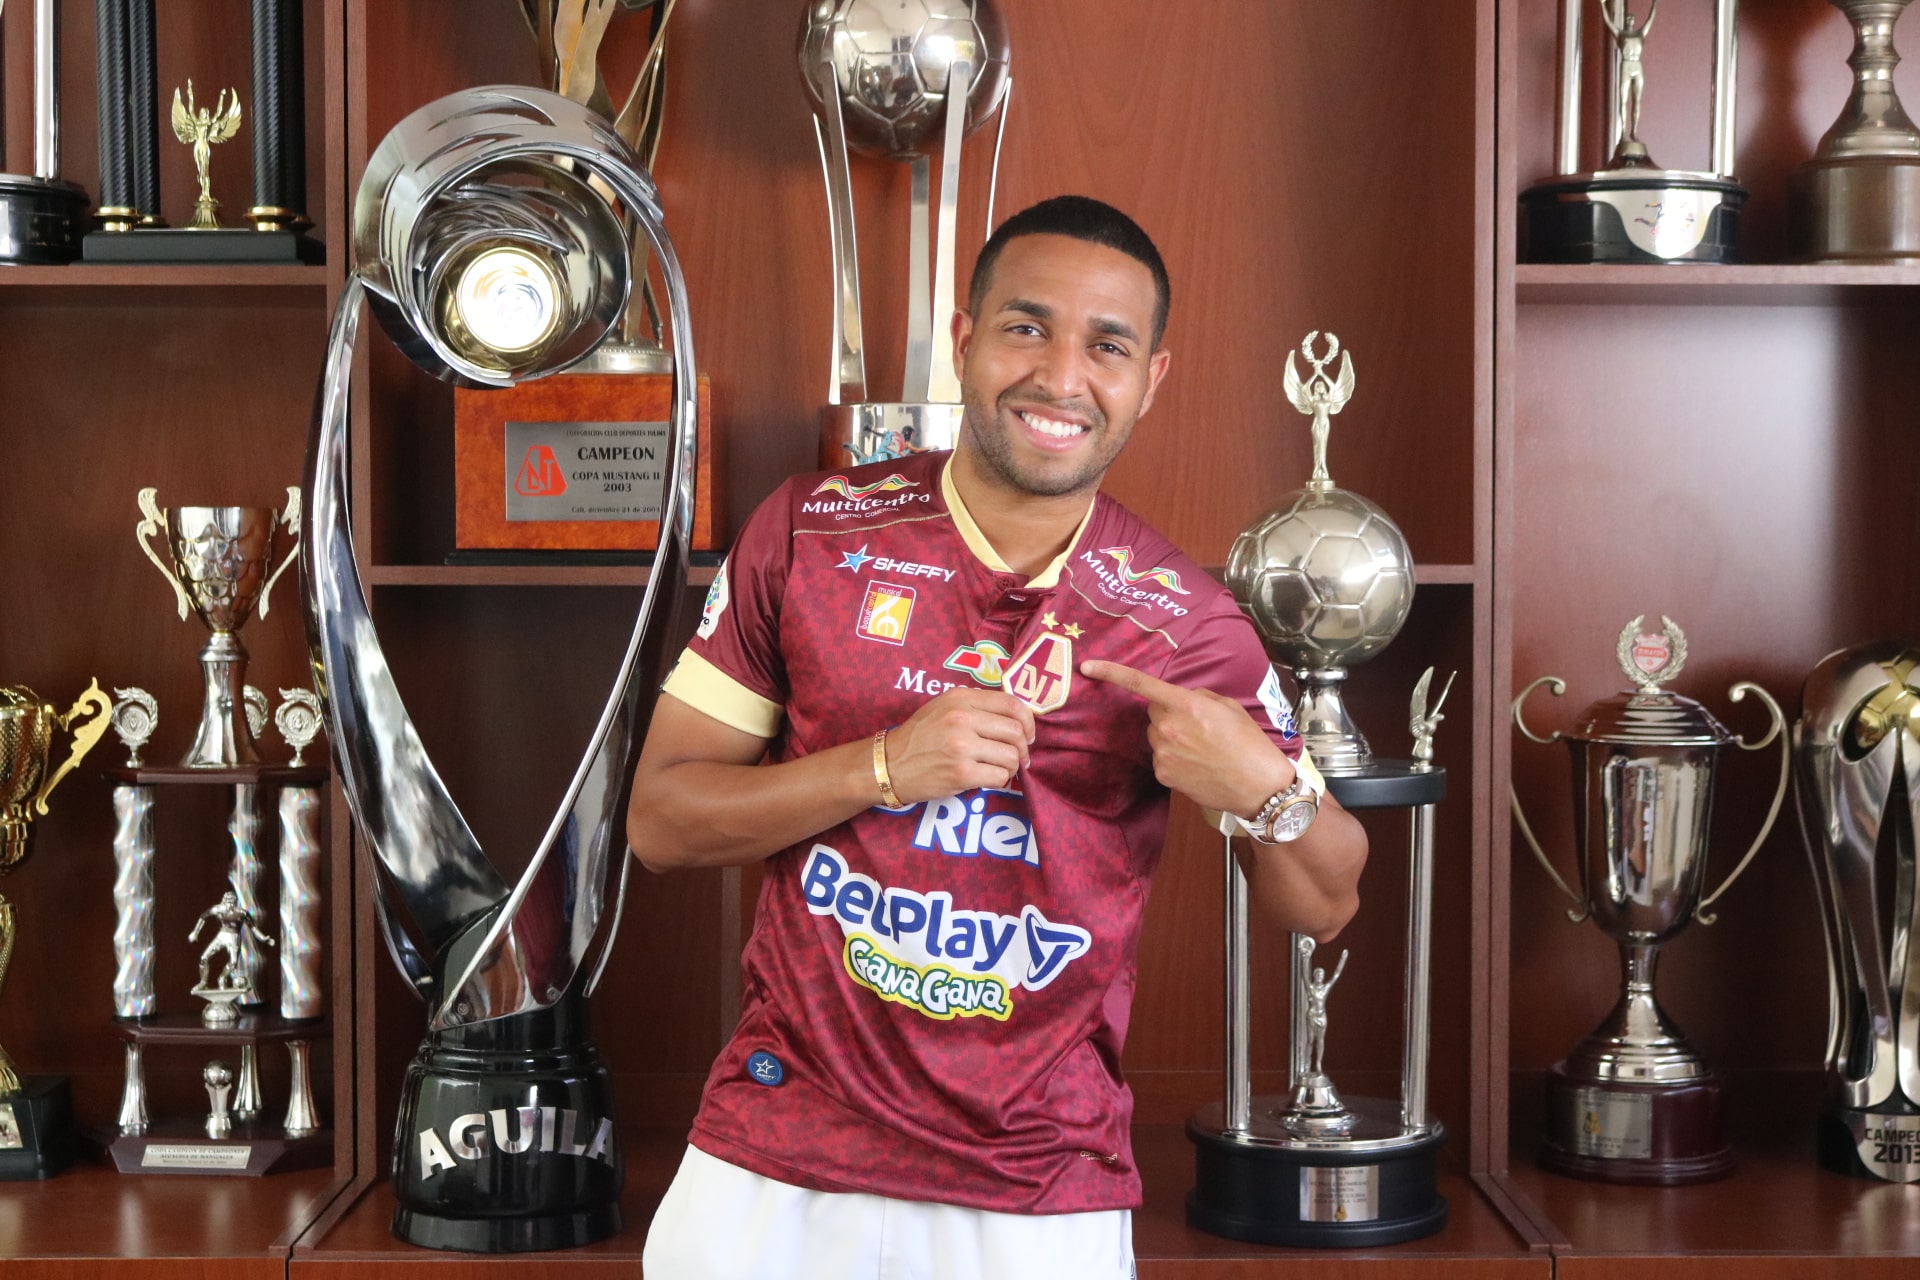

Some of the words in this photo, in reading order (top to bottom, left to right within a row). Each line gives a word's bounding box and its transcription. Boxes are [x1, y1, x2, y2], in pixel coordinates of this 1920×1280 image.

[577, 446, 655, 461] CAMPEON
[572, 471, 600, 481] COPA
[602, 471, 650, 481] MUSTANG
[603, 482, 632, 492] 2003
[835, 512, 862, 521] CENTRO
[872, 556, 956, 583] SHEFFY
[878, 587, 902, 596] musical
[1097, 582, 1118, 600] CENTRO
[418, 1105, 615, 1181] AGUILA
